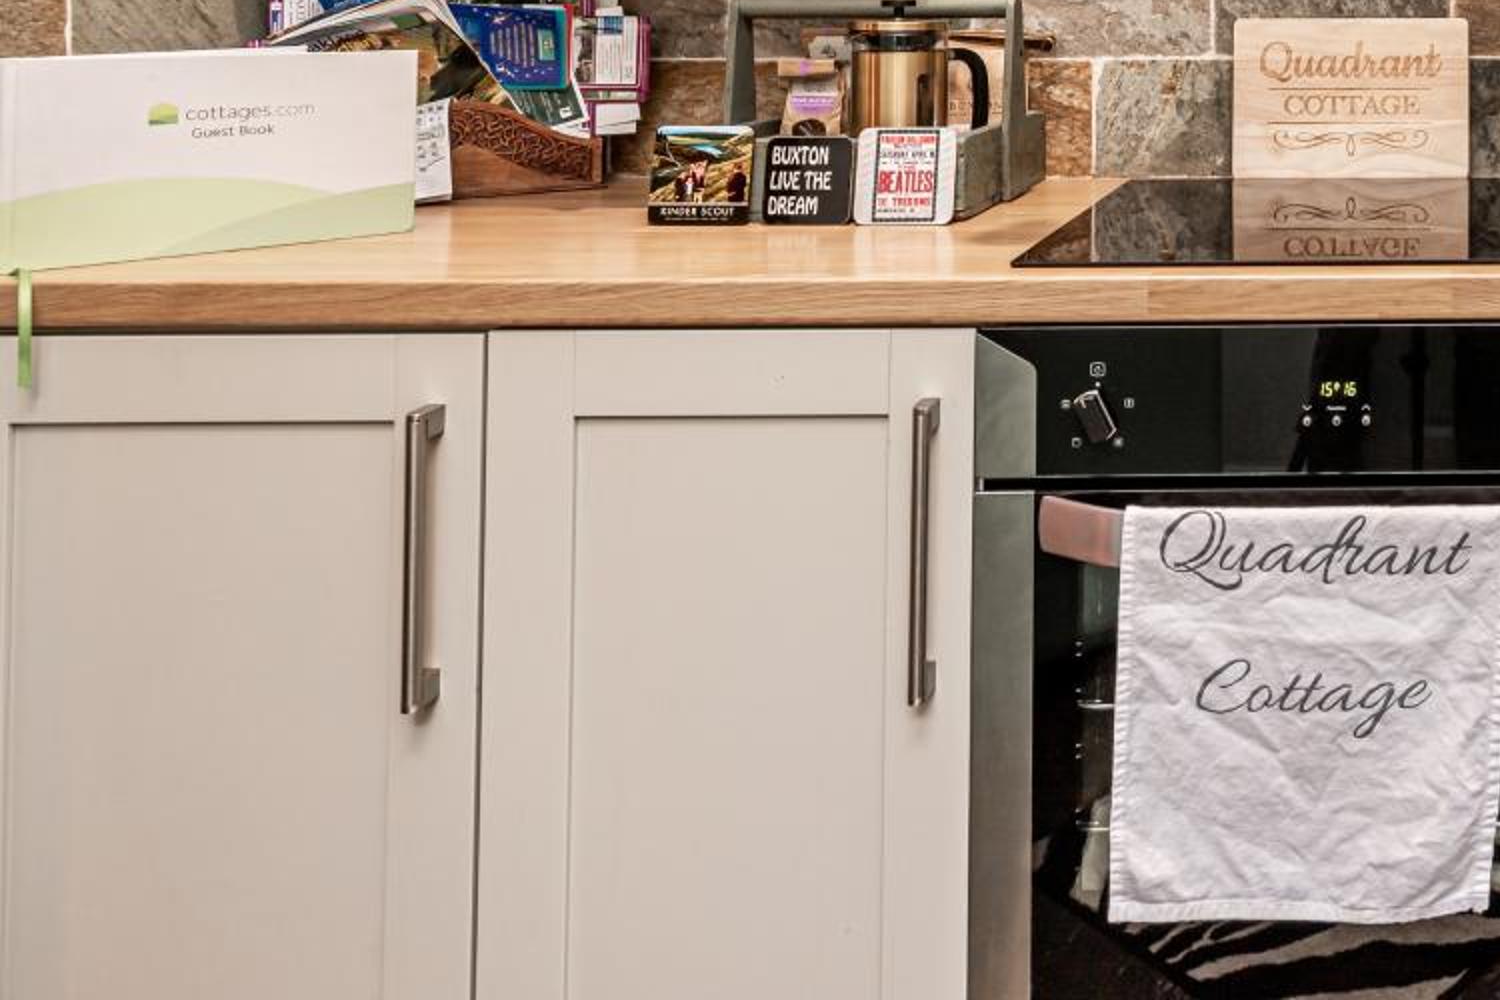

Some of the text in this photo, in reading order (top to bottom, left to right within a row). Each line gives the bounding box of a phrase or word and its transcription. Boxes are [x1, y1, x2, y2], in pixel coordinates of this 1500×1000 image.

[1259, 40, 1442, 83] Quadrant
[185, 103, 316, 122] cottages.com
[1283, 94, 1421, 116] COTTAGE
[191, 123, 275, 140] Guest Book
[772, 145, 829, 166] BUXTON
[769, 170, 833, 191] LIVE THE
[877, 170, 933, 194] BEATLES
[700, 207, 735, 217] SCOUT
[767, 195, 818, 216] DREAM
[1159, 508, 1472, 591] Quadrant
[1196, 658, 1433, 739] Cottage
